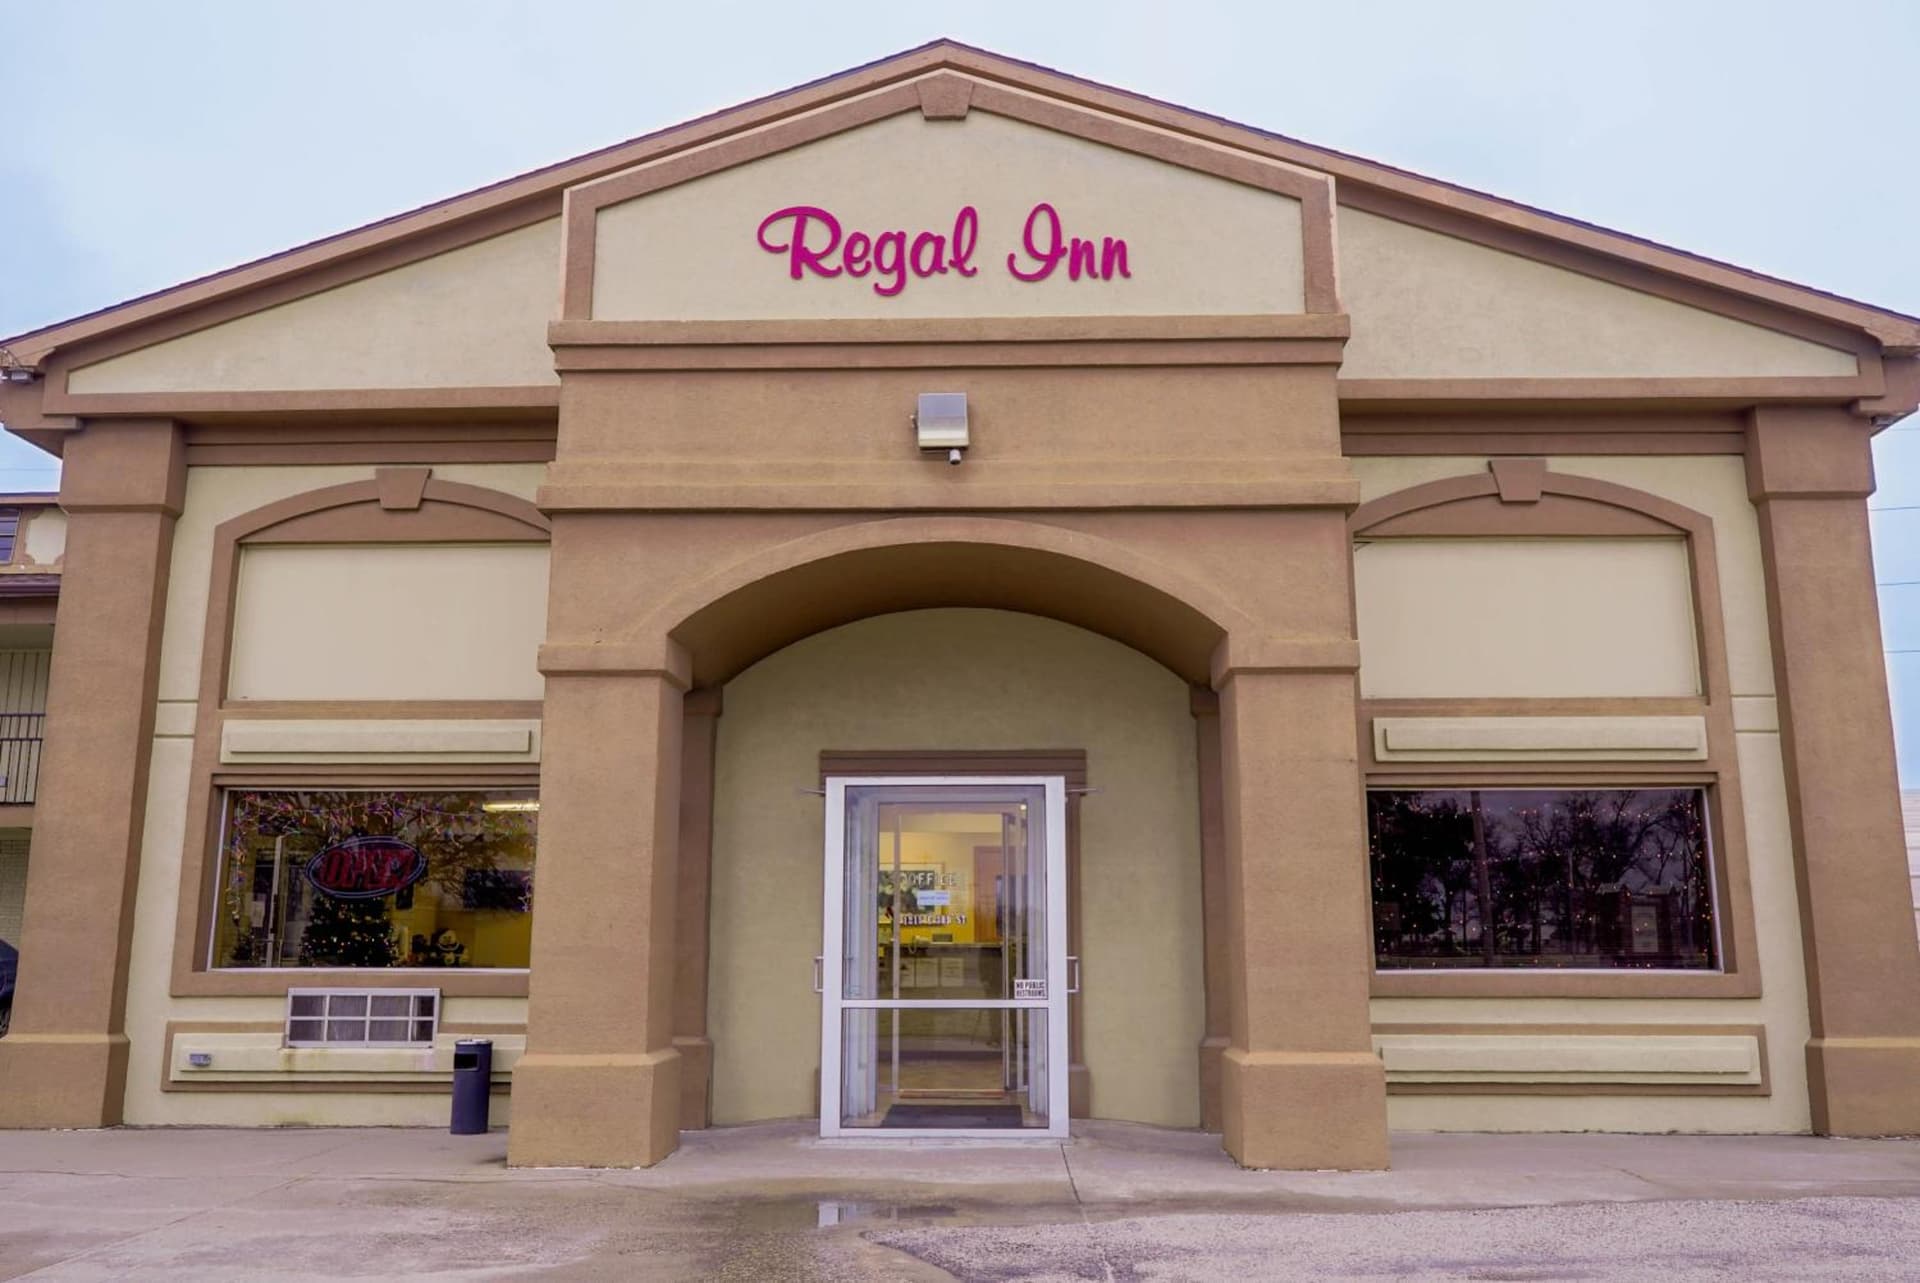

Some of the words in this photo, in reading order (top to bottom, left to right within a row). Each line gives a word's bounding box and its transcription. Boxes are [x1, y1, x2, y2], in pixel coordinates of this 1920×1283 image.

[757, 206, 978, 296] Regal
[1007, 203, 1131, 282] Inn
[318, 848, 416, 890] OPEN
[908, 872, 956, 886] OFFICE
[1016, 981, 1024, 989] NO
[1025, 981, 1045, 989] PUBLIC
